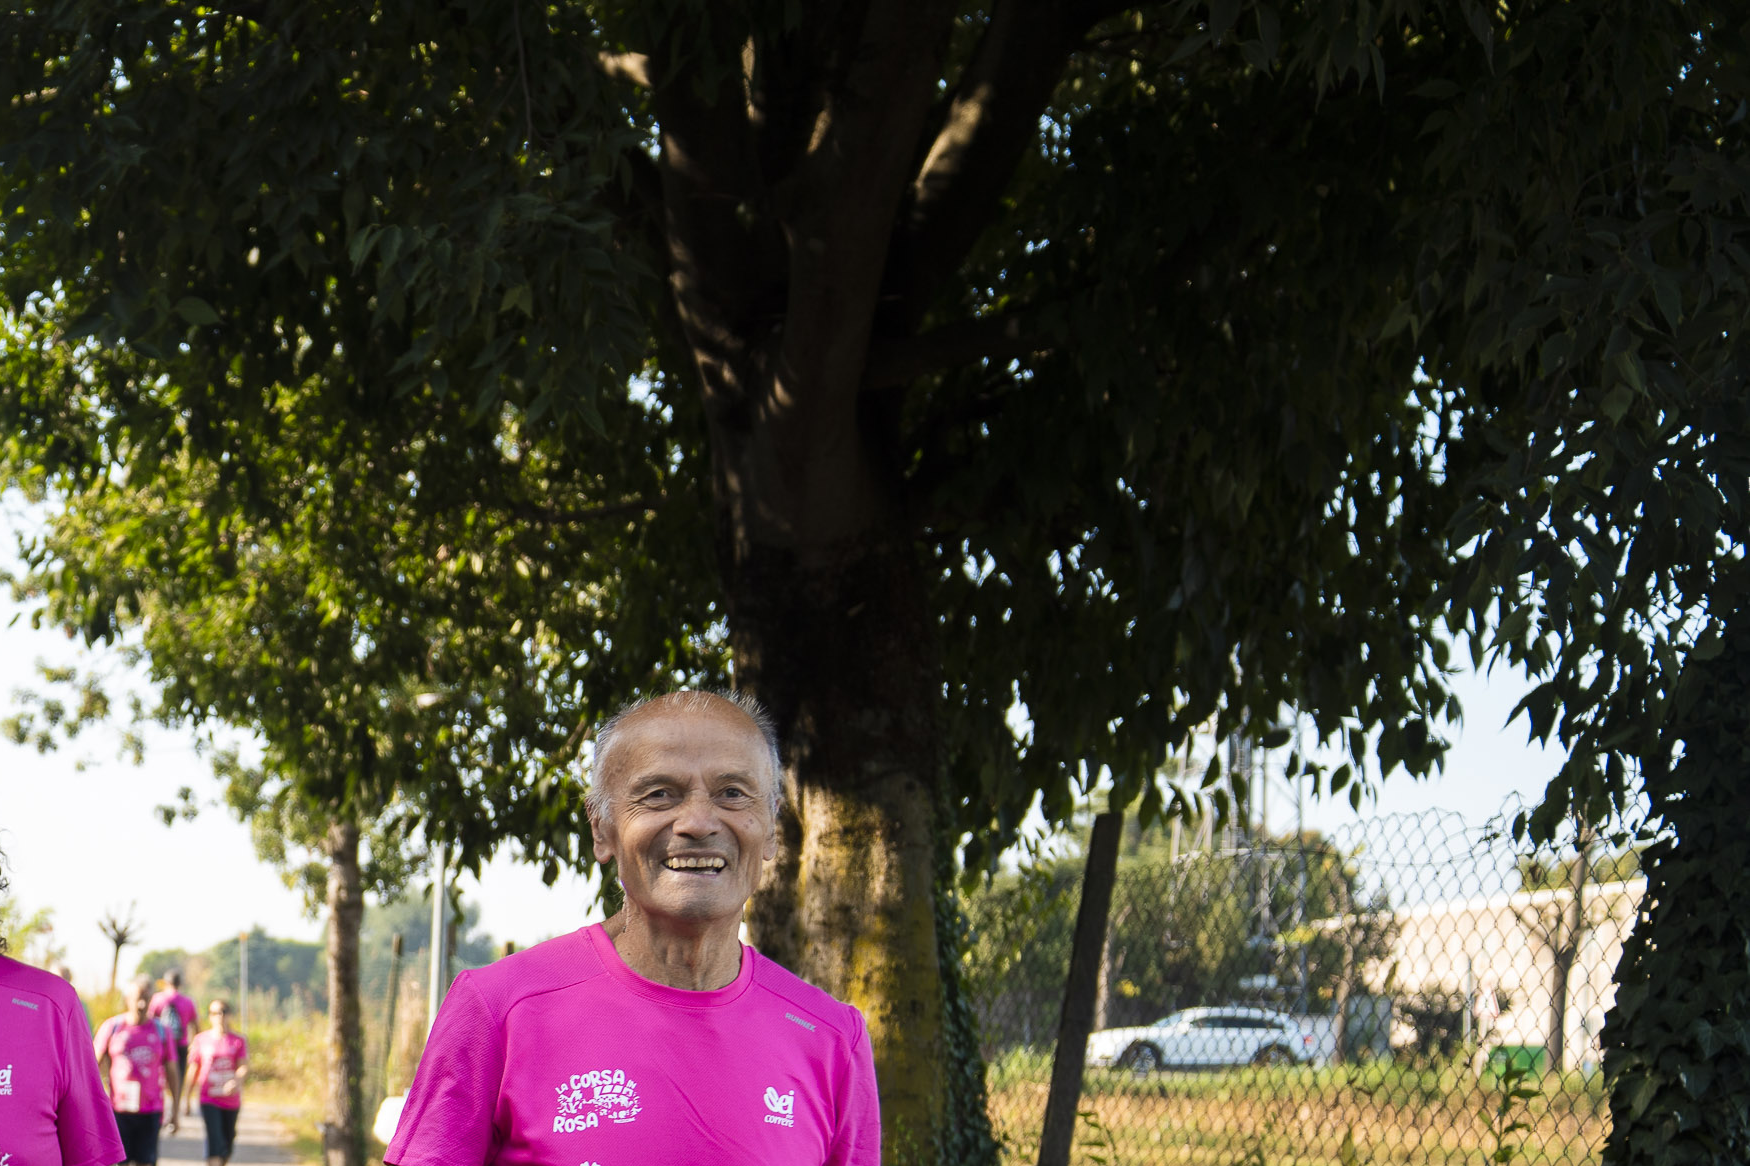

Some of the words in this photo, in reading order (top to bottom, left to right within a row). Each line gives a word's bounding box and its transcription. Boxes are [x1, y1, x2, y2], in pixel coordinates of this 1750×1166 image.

[570, 1068, 626, 1090] CORSA
[552, 1112, 599, 1133] ROSA
[764, 1114, 795, 1128] correre
